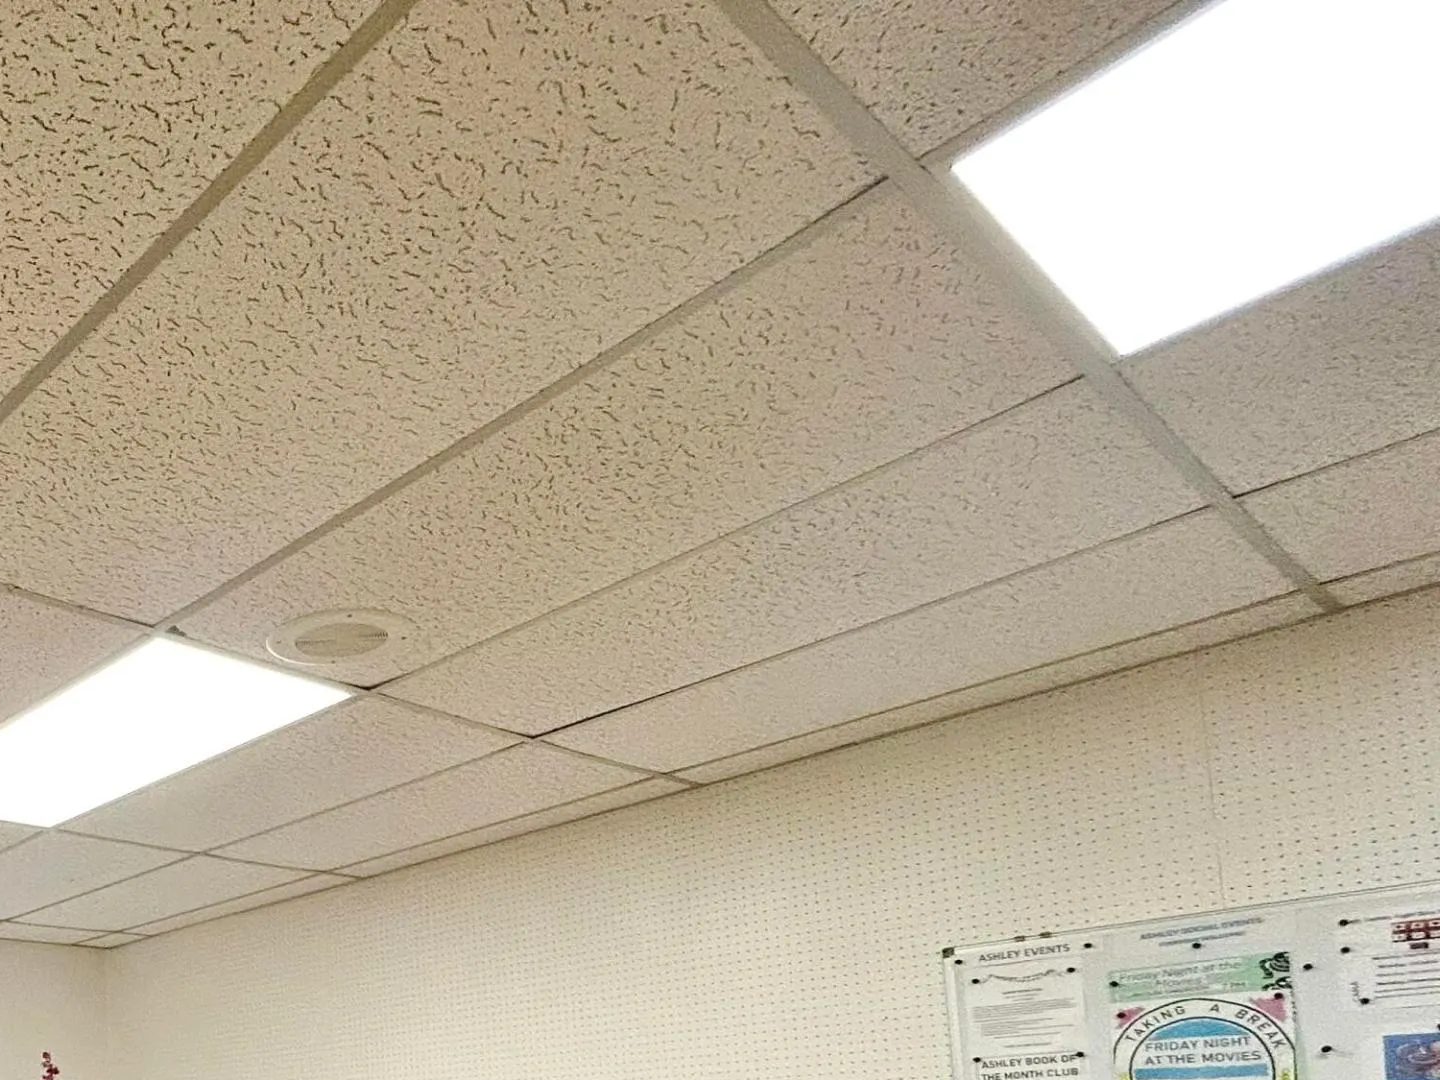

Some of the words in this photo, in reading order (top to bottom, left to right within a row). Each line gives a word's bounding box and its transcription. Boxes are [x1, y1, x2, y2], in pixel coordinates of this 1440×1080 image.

[979, 950, 1020, 961] ASHLEY
[1024, 943, 1071, 957] EVENTS
[1126, 1006, 1186, 1042] TAKING
[1209, 1003, 1221, 1013] A
[1235, 1008, 1287, 1049] BREAK
[1145, 1039, 1199, 1052] FRIDAY
[1203, 1036, 1251, 1048] NIGHT
[981, 1058, 1022, 1069] ASHLEY
[1025, 1055, 1058, 1066] BOOK
[1060, 1055, 1077, 1063] OF
[1145, 1055, 1162, 1066] AT
[1166, 1053, 1196, 1064] THE
[1202, 1050, 1262, 1063] MOVIES
[982, 1073, 1002, 1080] THE
[1004, 1070, 1044, 1080] MONTH
[1047, 1067, 1079, 1077] CLUB
